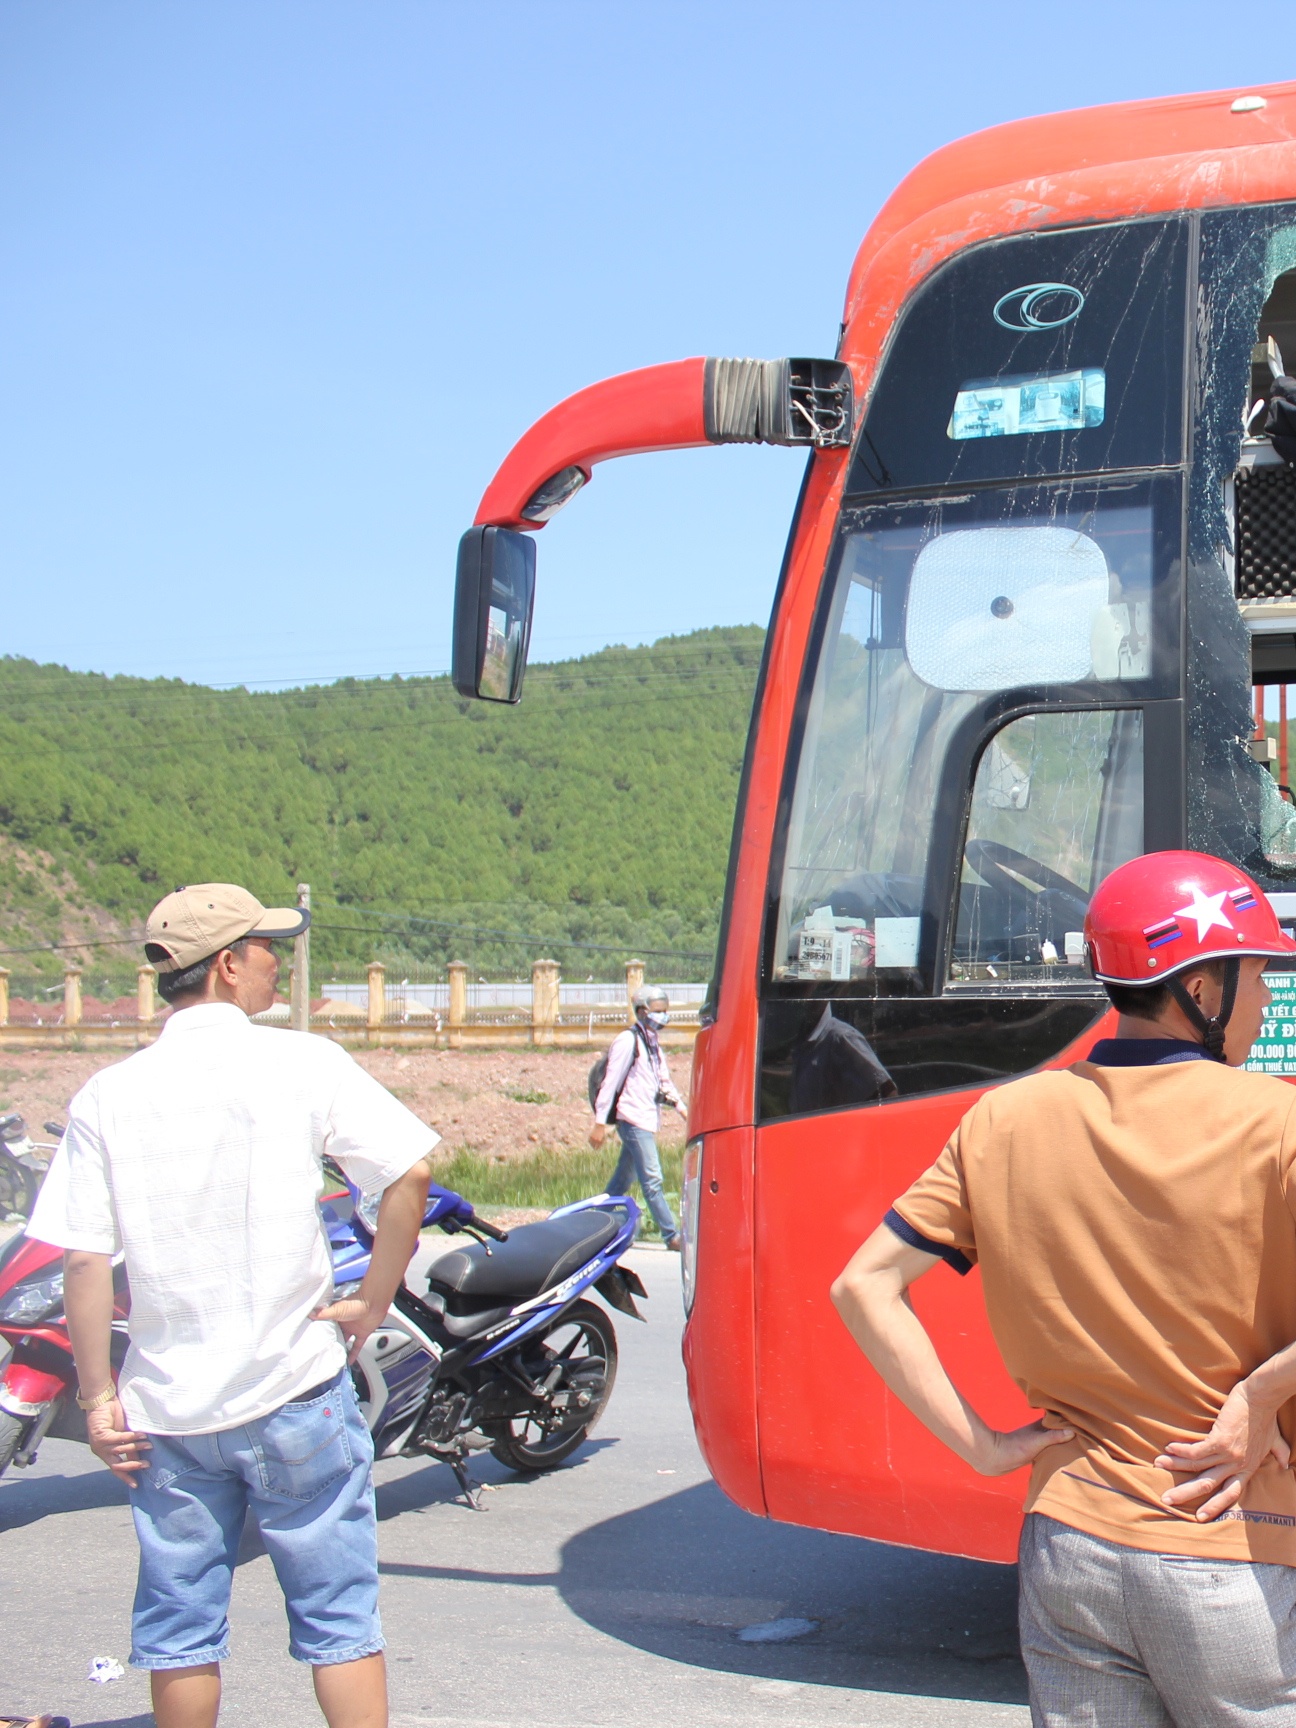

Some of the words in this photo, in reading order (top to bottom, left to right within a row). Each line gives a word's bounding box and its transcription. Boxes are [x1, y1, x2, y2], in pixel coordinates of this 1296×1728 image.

[1263, 977, 1291, 989] HANH
[1271, 1003, 1290, 1016] YẾT
[1265, 1059, 1283, 1072] THUẾ
[1261, 1516, 1292, 1527] ARMANI
